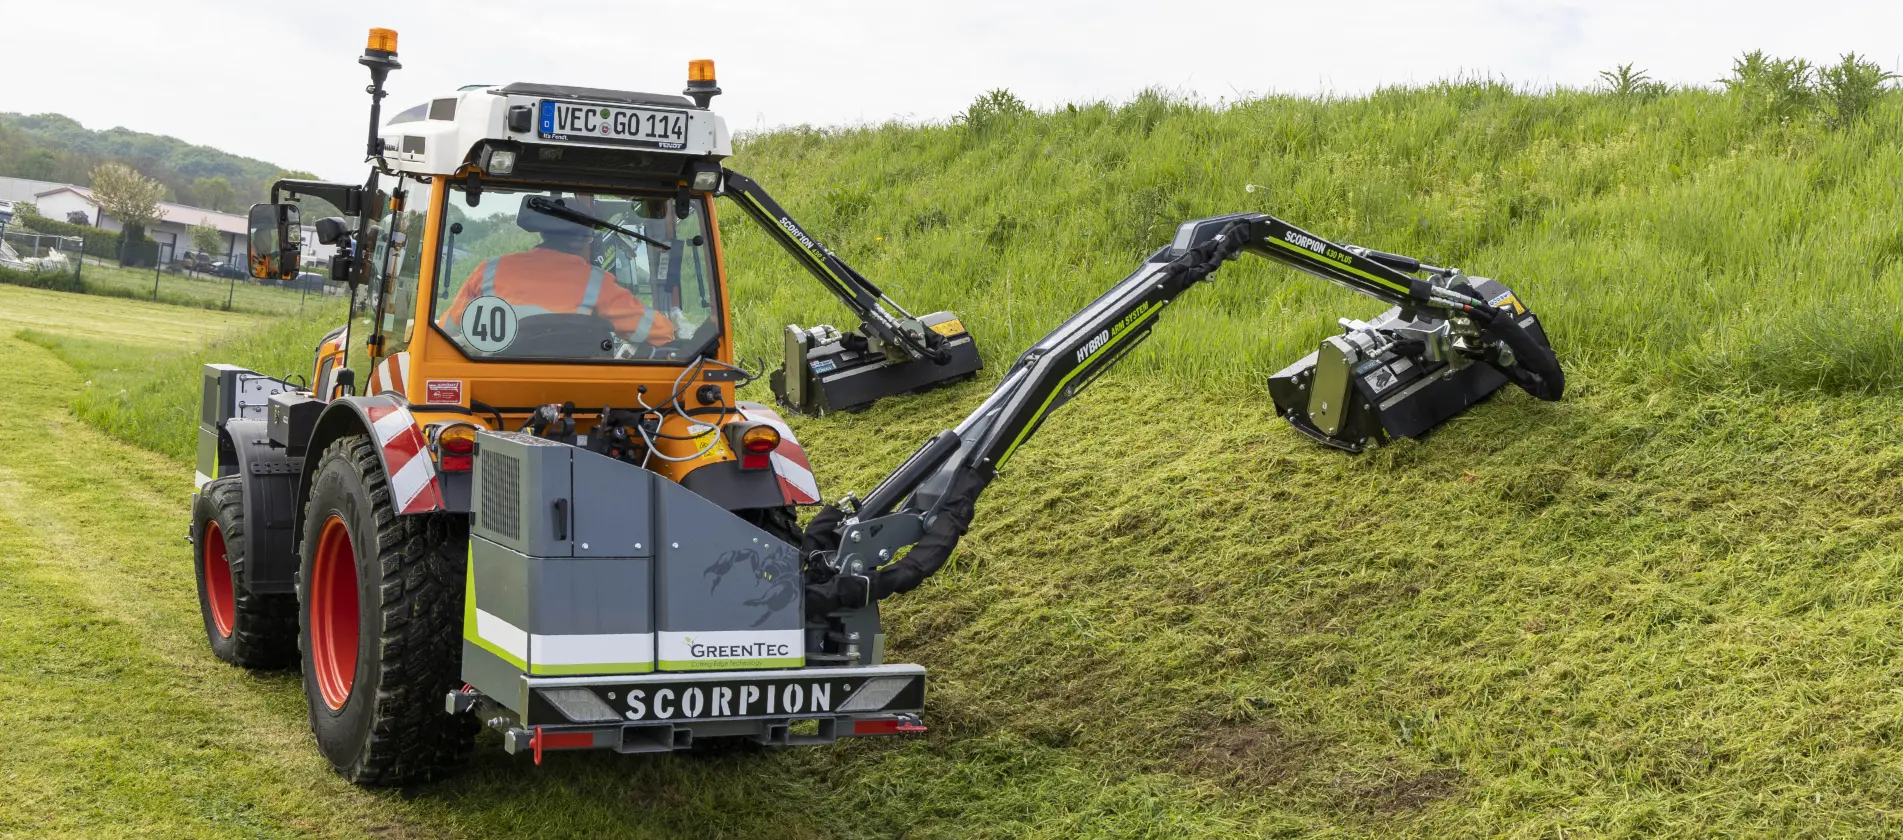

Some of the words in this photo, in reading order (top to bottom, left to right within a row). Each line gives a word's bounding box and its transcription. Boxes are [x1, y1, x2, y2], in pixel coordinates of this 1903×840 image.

[544, 120, 550, 128] D
[557, 106, 597, 132] VEC
[613, 111, 640, 136] GO
[645, 114, 683, 140] 114
[779, 217, 815, 249] SCORPION
[1284, 231, 1327, 255] SCORPION
[1325, 248, 1338, 259] 430
[1337, 252, 1353, 265] PLUS
[472, 305, 506, 343] 40
[1076, 329, 1110, 363] HYBRID
[1111, 319, 1125, 337] ARM
[1125, 300, 1149, 326] SYSTEM
[690, 661, 713, 669] Cutting
[729, 660, 762, 668] Technology
[625, 682, 831, 720] SCORPION
